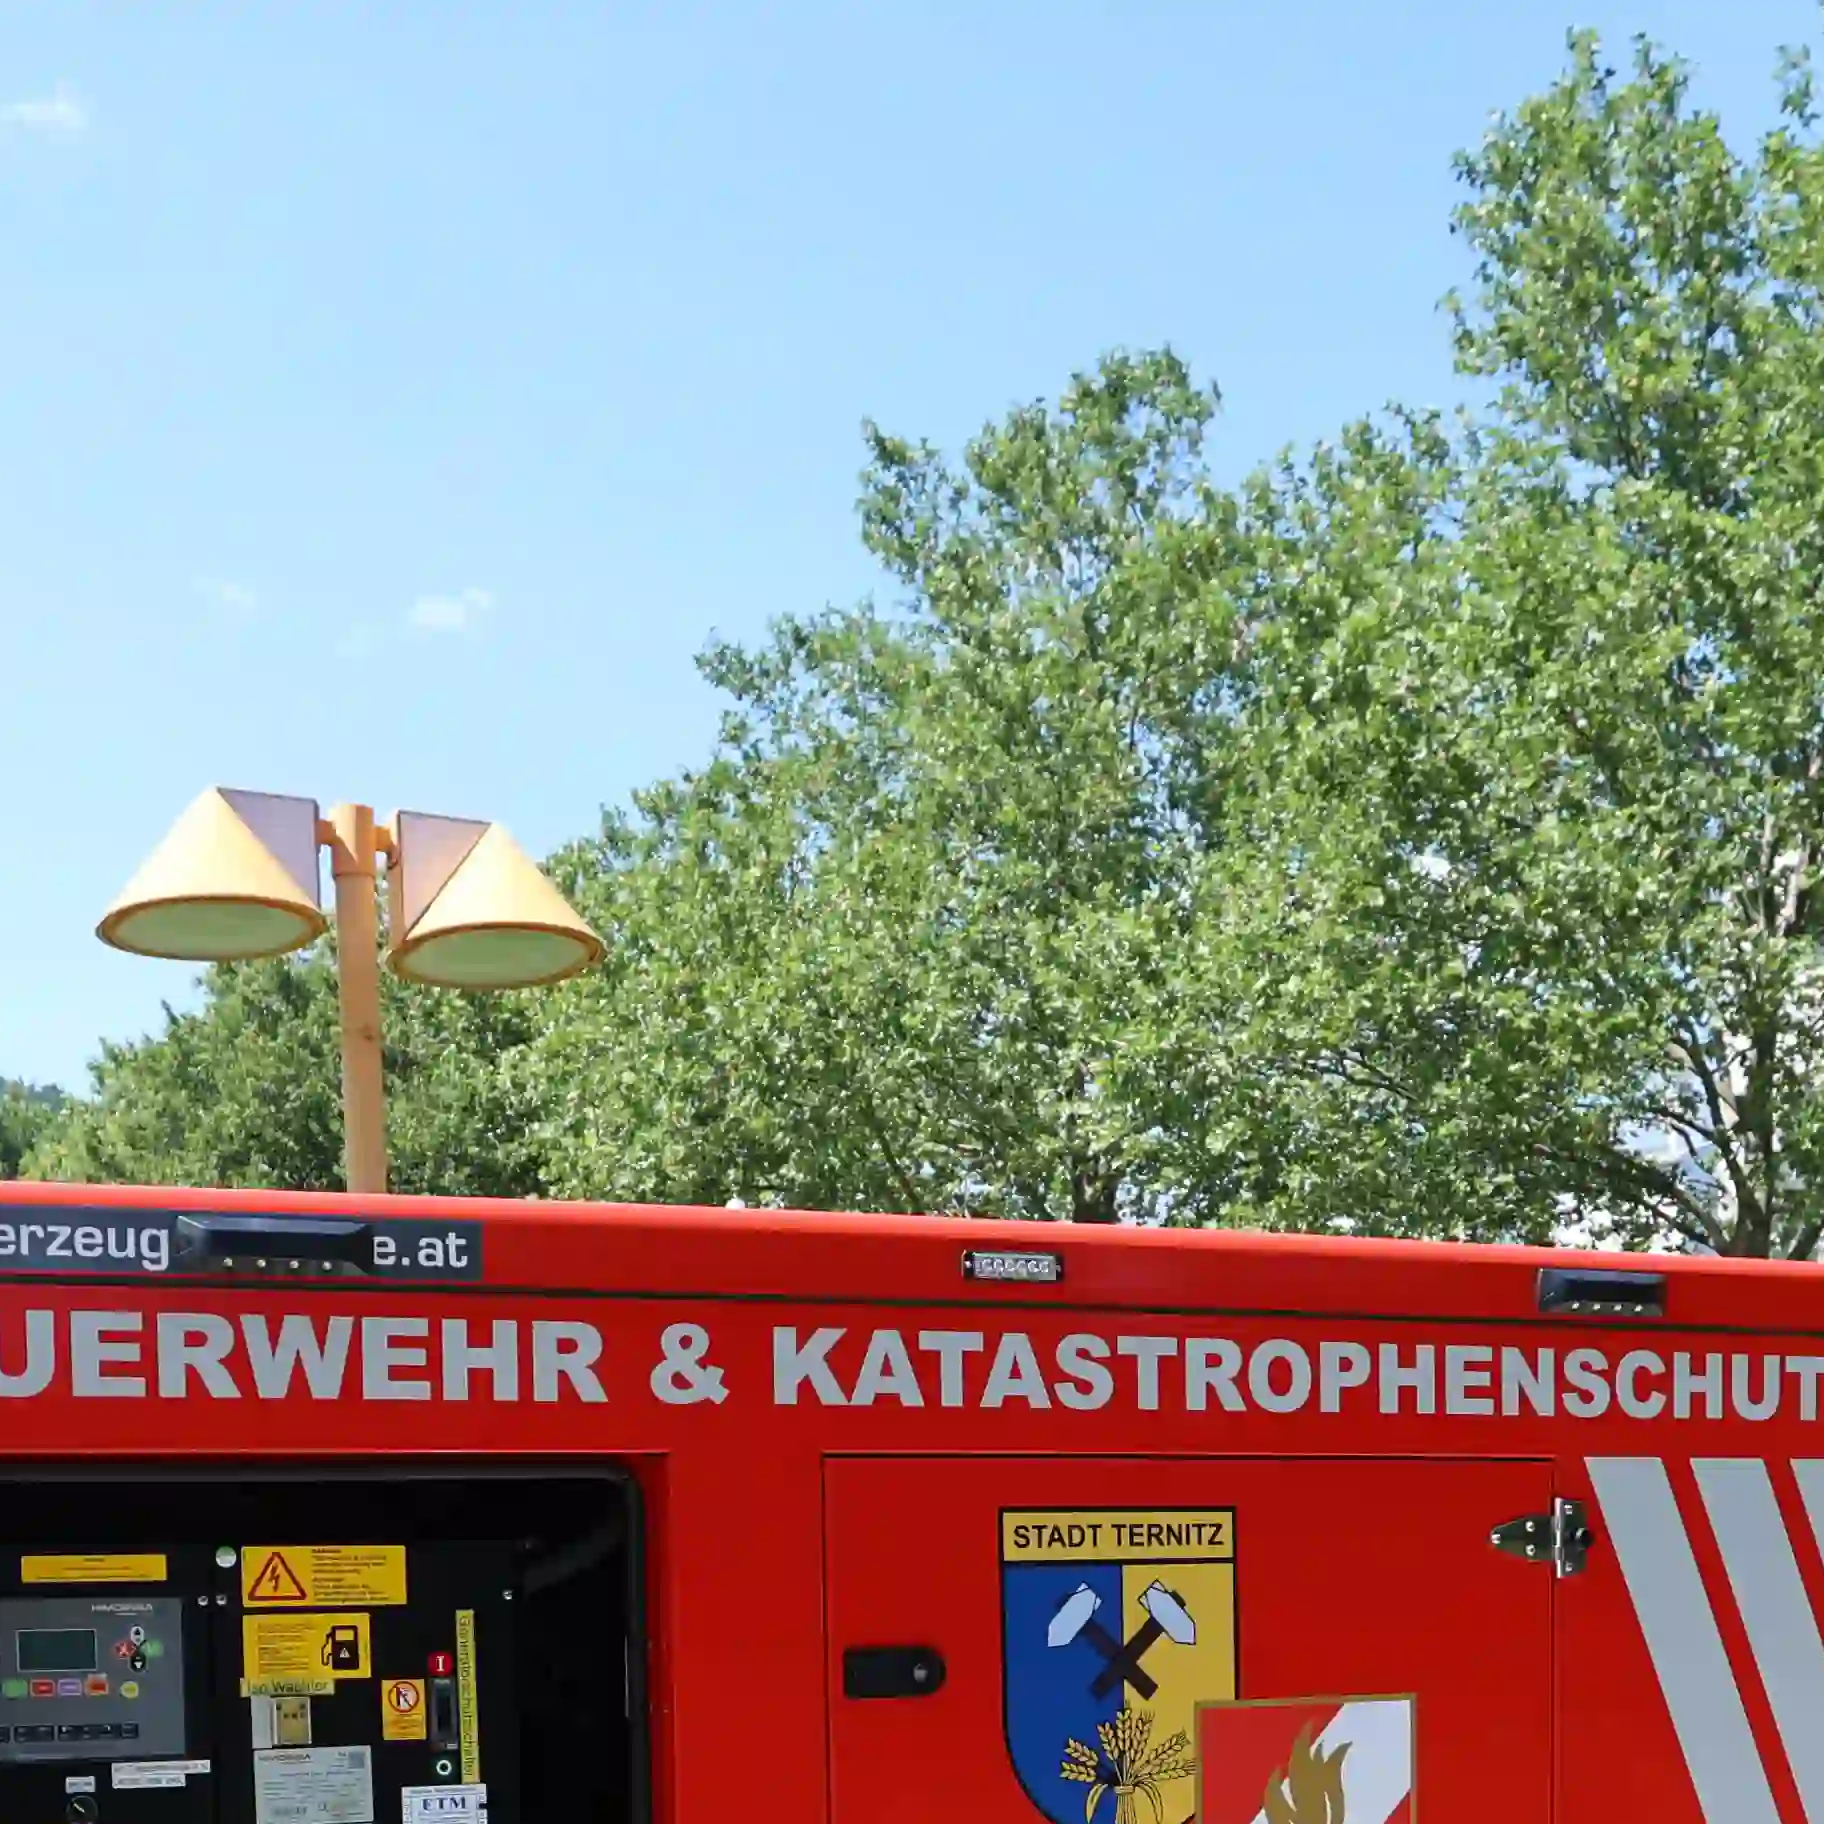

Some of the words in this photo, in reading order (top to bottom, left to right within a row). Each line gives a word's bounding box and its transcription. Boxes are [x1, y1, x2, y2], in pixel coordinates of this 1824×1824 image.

[649, 1322, 730, 1405] &
[1013, 1524, 1102, 1548] STADT
[1111, 1523, 1224, 1547] TERNITZ
